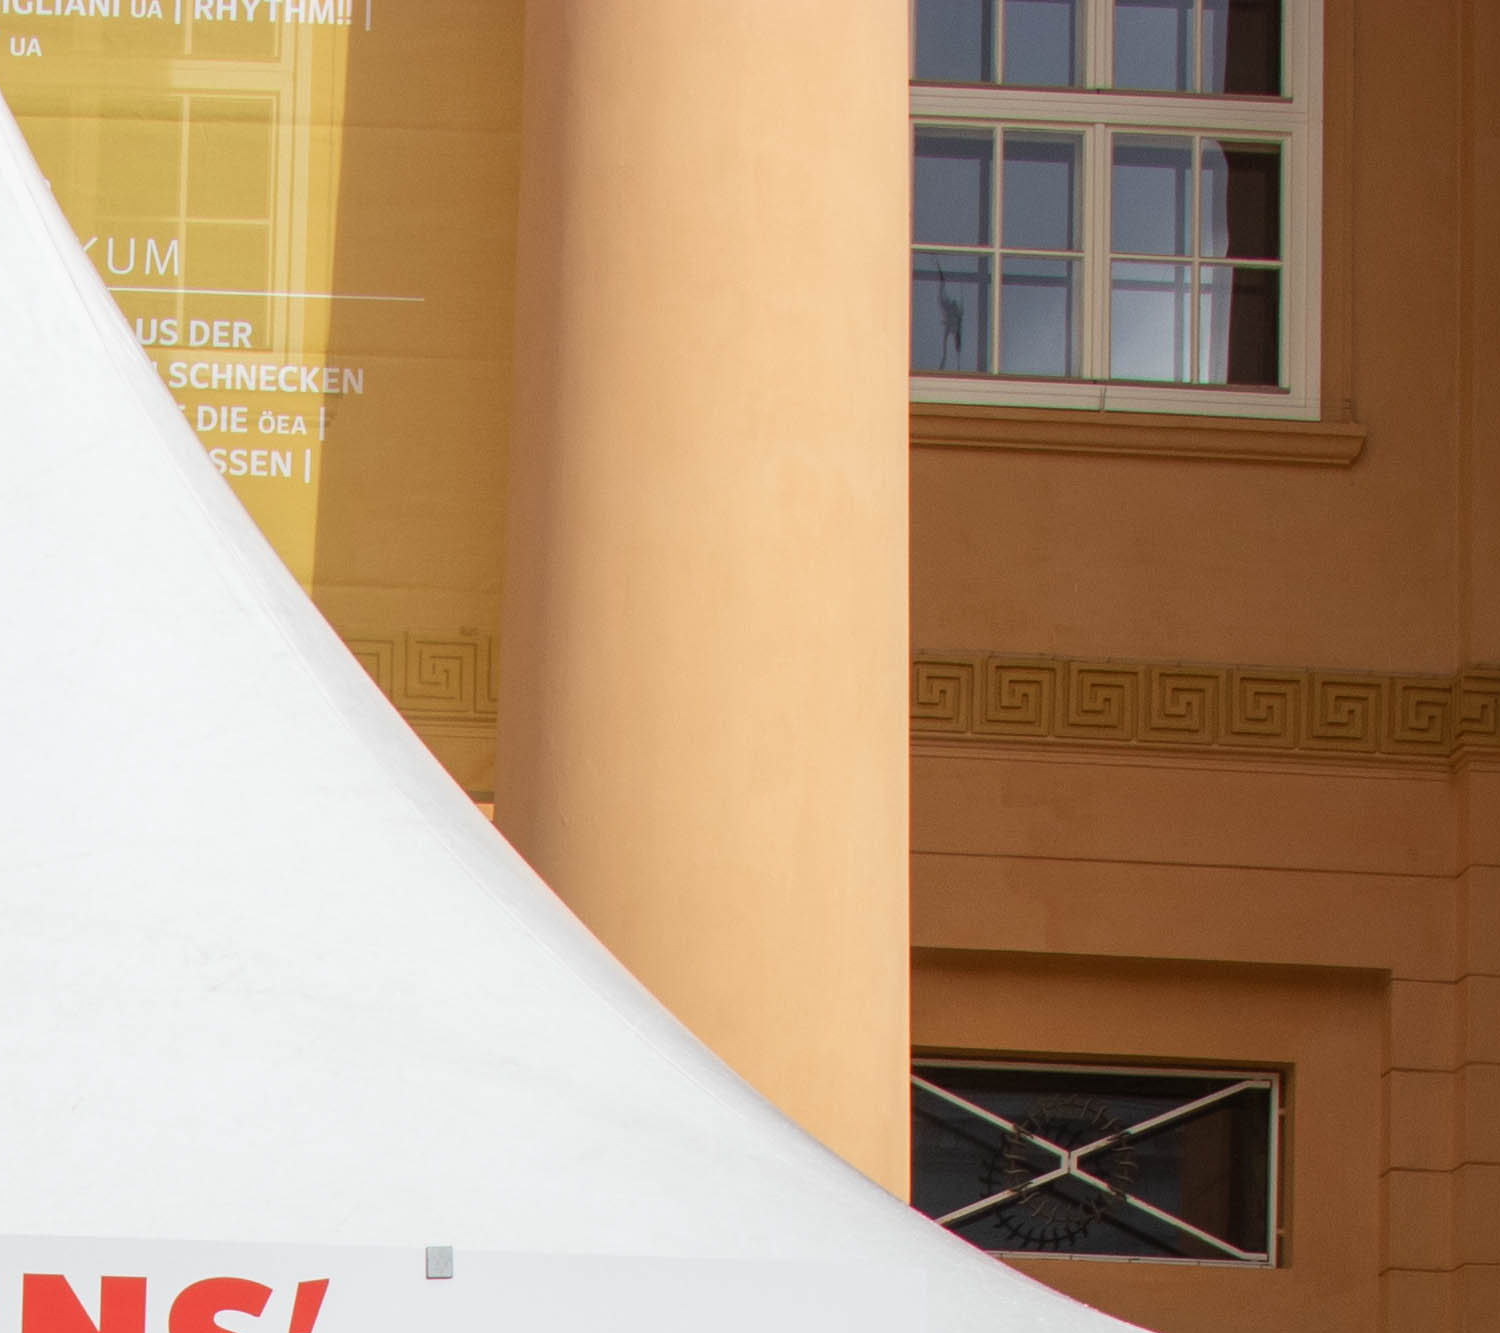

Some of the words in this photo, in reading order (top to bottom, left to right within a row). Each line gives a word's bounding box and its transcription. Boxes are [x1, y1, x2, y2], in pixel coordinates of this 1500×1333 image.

[10, 36, 42, 57] UA
[189, 321, 252, 348] DER
[168, 362, 364, 394] SCHNECKEN
[197, 405, 248, 433] DIE
[258, 410, 307, 435] ÖEA
